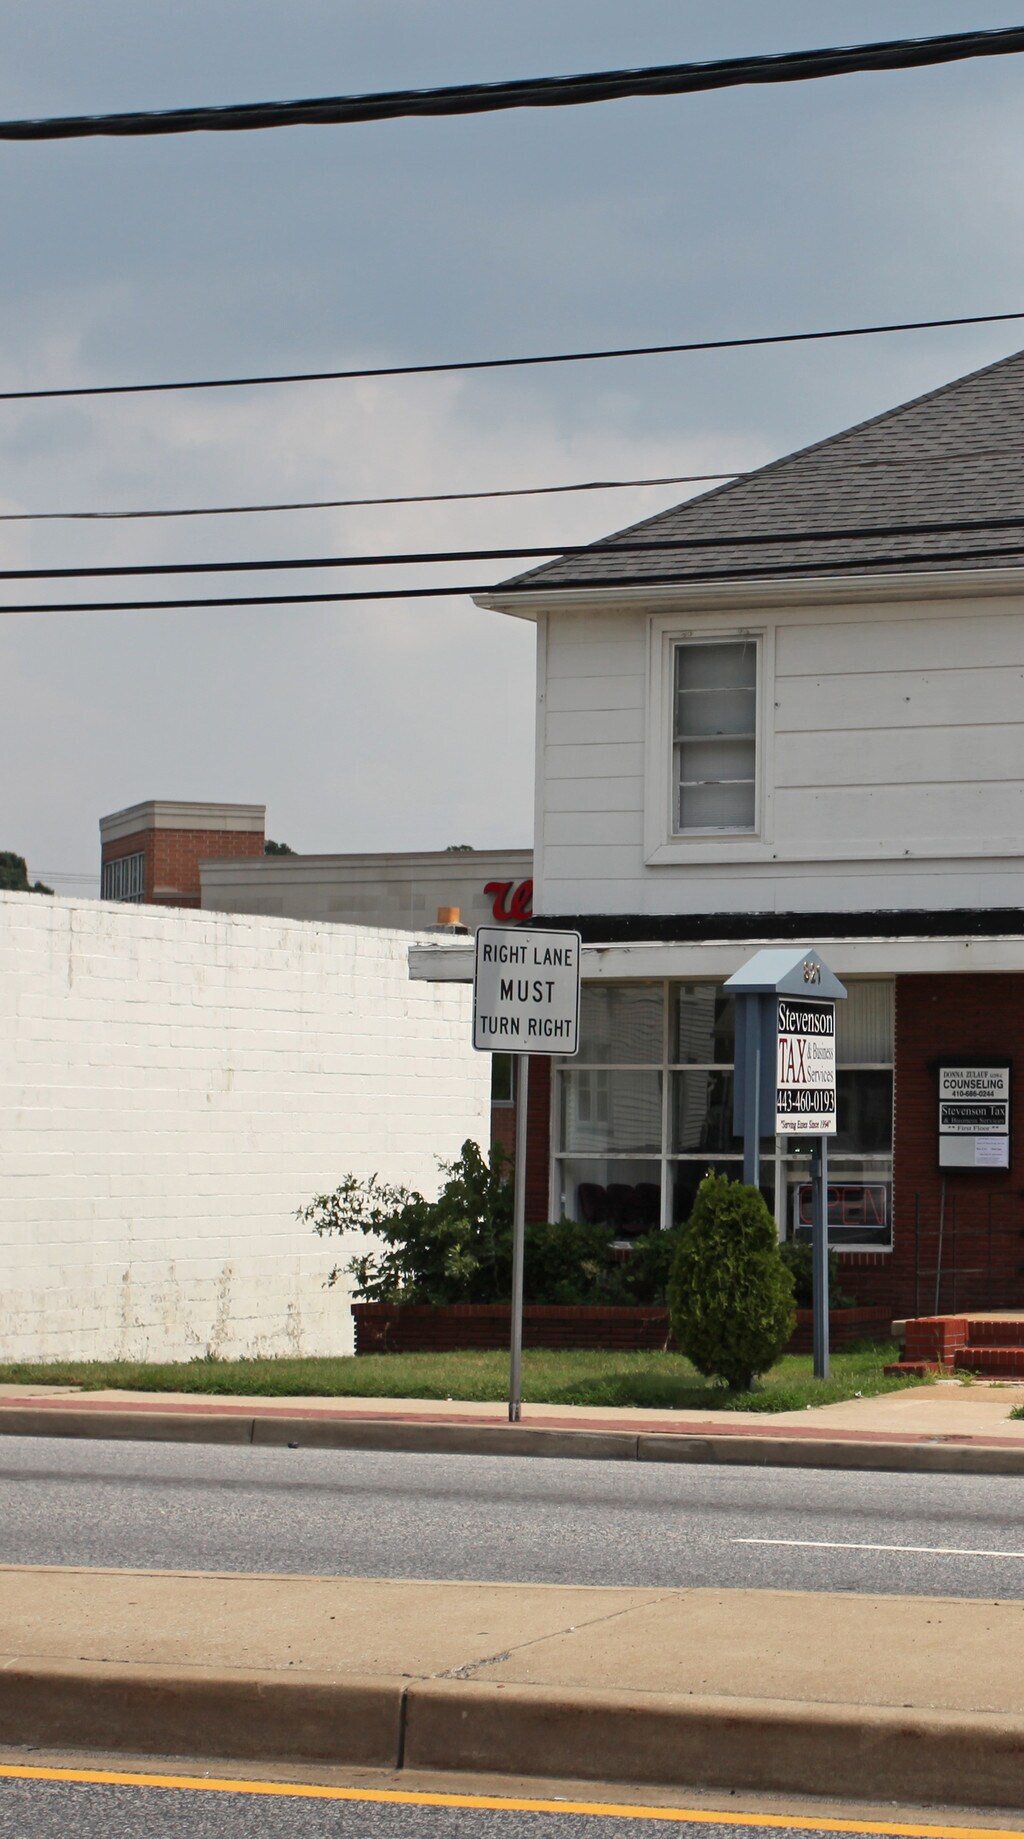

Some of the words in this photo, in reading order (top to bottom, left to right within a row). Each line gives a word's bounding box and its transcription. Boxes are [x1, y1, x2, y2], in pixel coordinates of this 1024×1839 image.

[483, 944, 527, 964] RIGHT
[534, 948, 572, 967] LANE
[803, 961, 821, 986] 821
[500, 979, 555, 1003] MUST
[480, 1016, 520, 1035] TURN
[528, 1018, 572, 1037] RIGHT
[779, 1003, 833, 1033] Stevenson
[779, 1038, 807, 1083] TAX
[813, 1042, 834, 1060] Business
[807, 1065, 834, 1083] Services
[943, 1071, 964, 1079] DONNA
[966, 1071, 989, 1079] ZULAUF
[943, 1079, 1004, 1089] COUNSELING
[777, 1091, 835, 1112] 443-460-0193
[942, 1106, 987, 1116] Stevenson
[989, 1106, 1006, 1116] Tax
